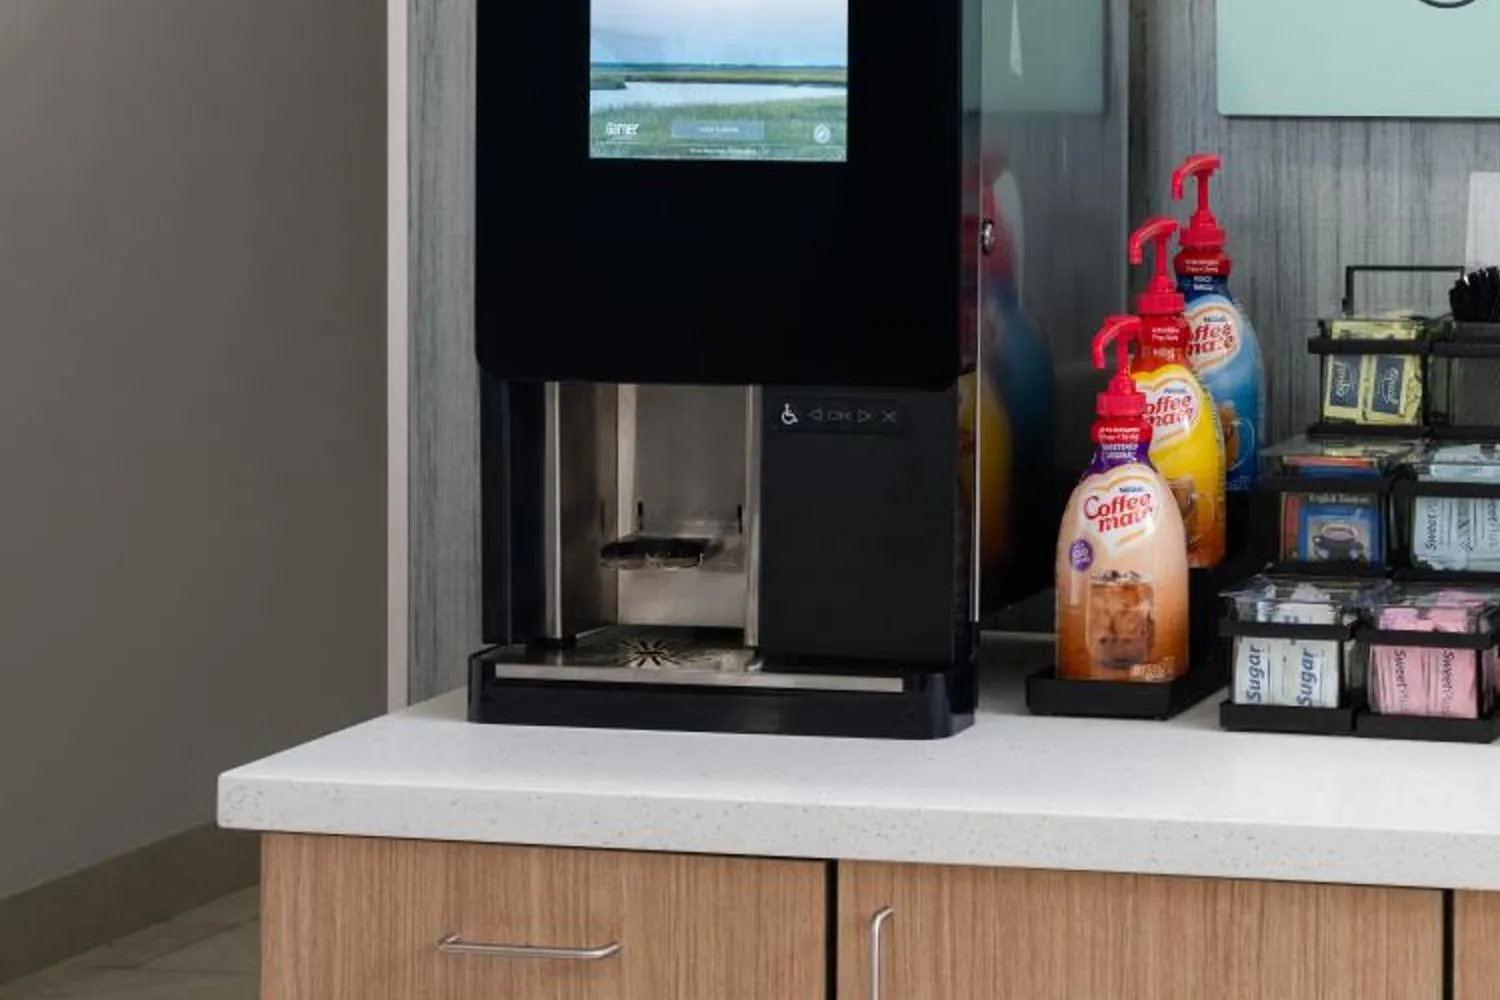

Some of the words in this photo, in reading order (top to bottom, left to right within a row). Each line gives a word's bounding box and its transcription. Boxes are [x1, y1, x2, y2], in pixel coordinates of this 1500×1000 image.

[1083, 492, 1153, 520] Coffee
[1246, 643, 1265, 703] Sugar
[1296, 647, 1318, 706] Sugar
